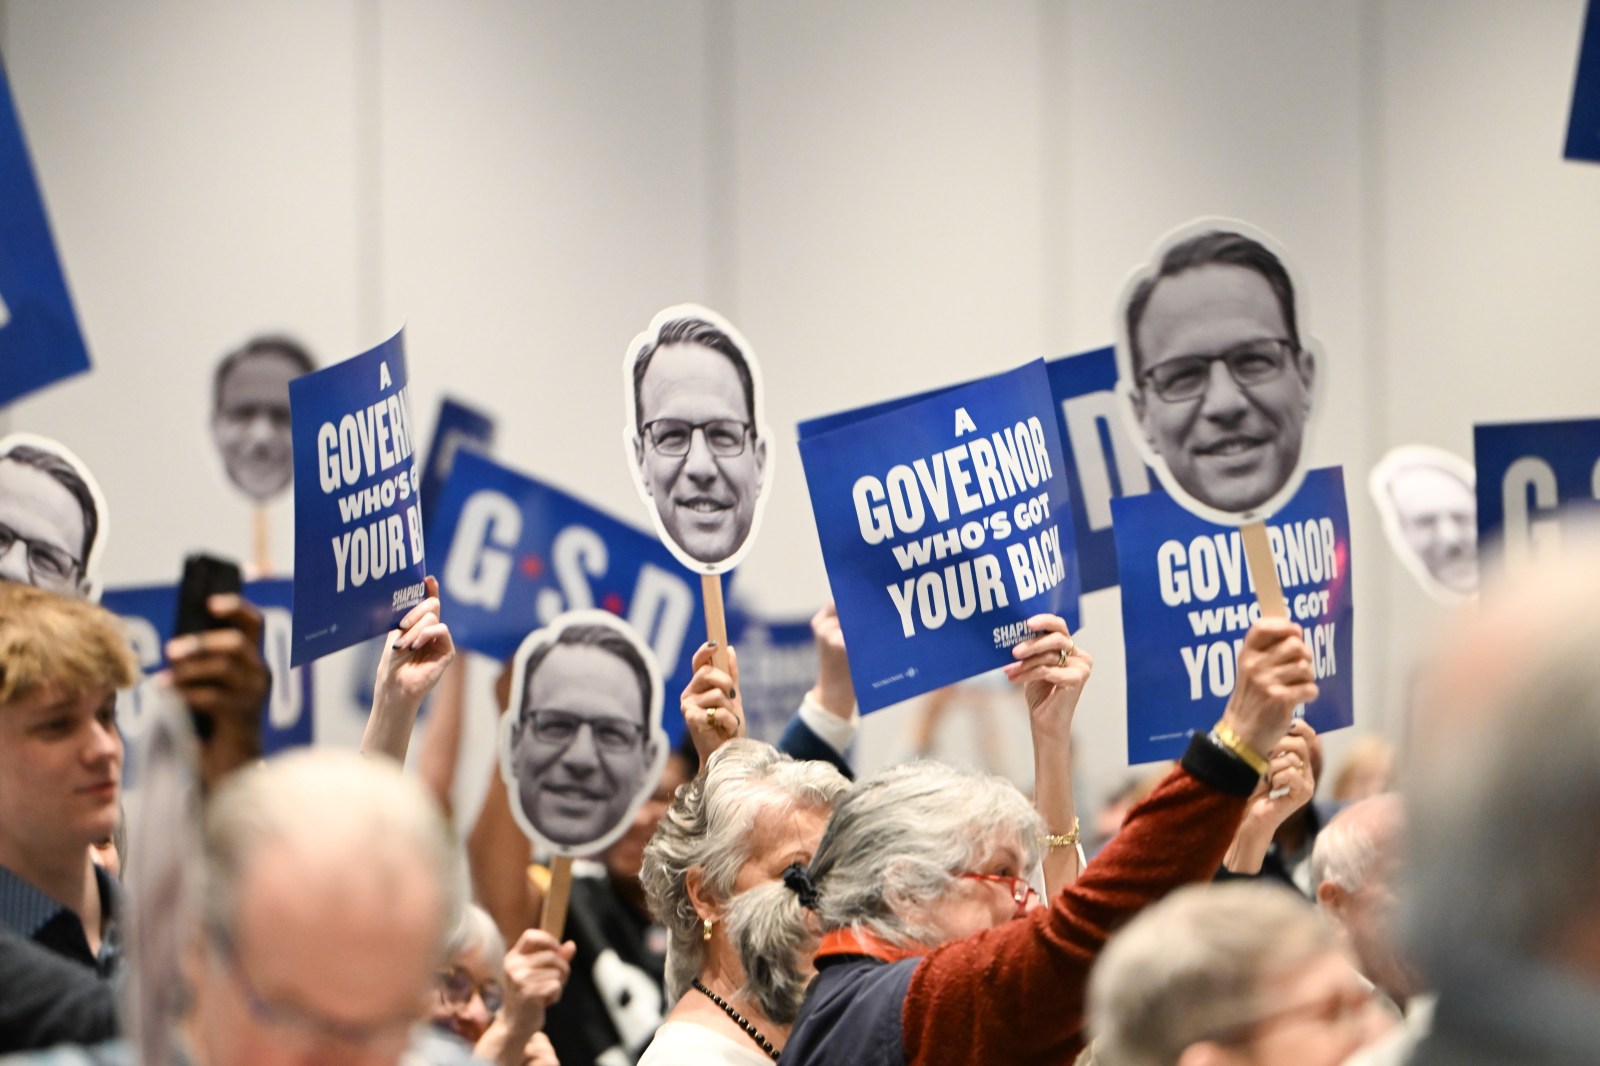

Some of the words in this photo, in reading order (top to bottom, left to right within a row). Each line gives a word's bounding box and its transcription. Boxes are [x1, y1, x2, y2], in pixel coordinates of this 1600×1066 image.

[380, 361, 392, 391] A
[318, 386, 415, 494] GOVERN
[954, 407, 977, 438] A
[338, 471, 411, 524] WHO'S
[852, 416, 1053, 545] GOVERNOR
[331, 514, 407, 593] YOUR
[892, 510, 1012, 571] WHO'S
[1013, 492, 1051, 530] GOT
[392, 580, 425, 607] SHAPIRO
[886, 553, 1009, 639] YOUR
[1006, 524, 1066, 602] BACK
[1293, 590, 1330, 620] GOT
[993, 619, 1031, 644] SHAPI
